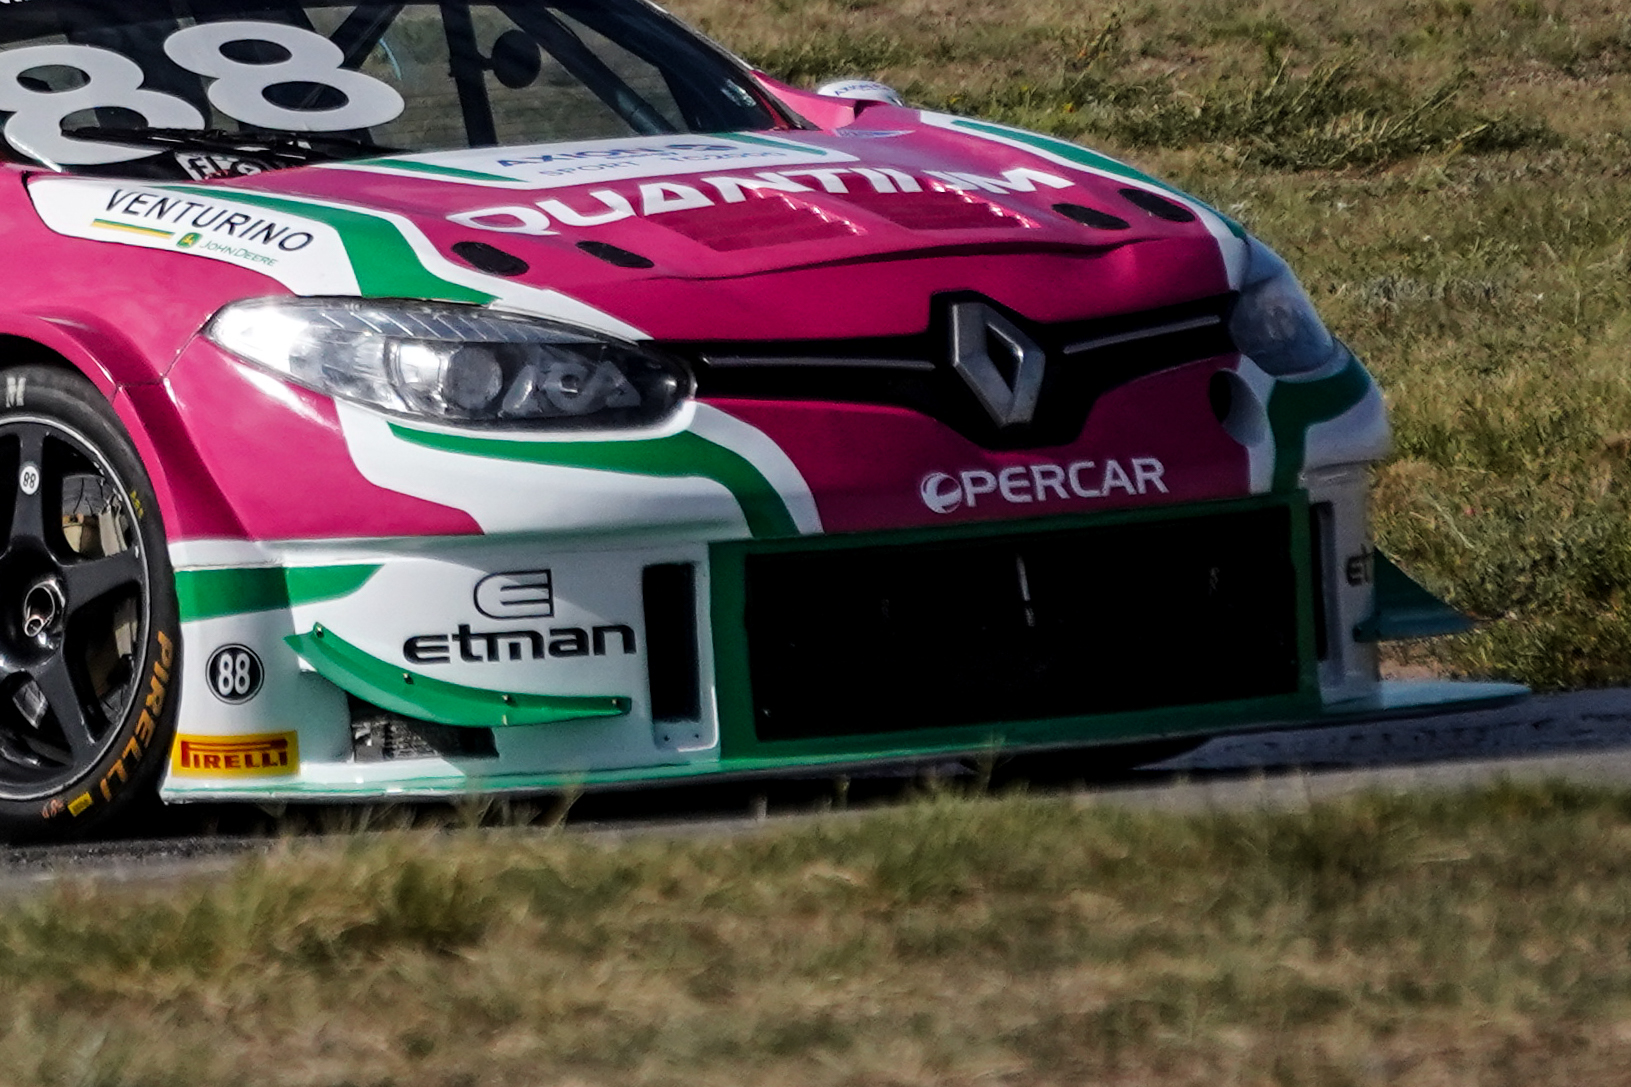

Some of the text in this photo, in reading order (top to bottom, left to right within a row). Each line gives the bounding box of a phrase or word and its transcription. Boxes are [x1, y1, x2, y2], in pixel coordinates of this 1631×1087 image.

[105, 188, 314, 252] VENTURINO
[445, 167, 1075, 235] QUANTIUM
[216, 654, 251, 696] 88
[100, 630, 173, 802] PIRELLI
[181, 738, 289, 770] PIRELLI
